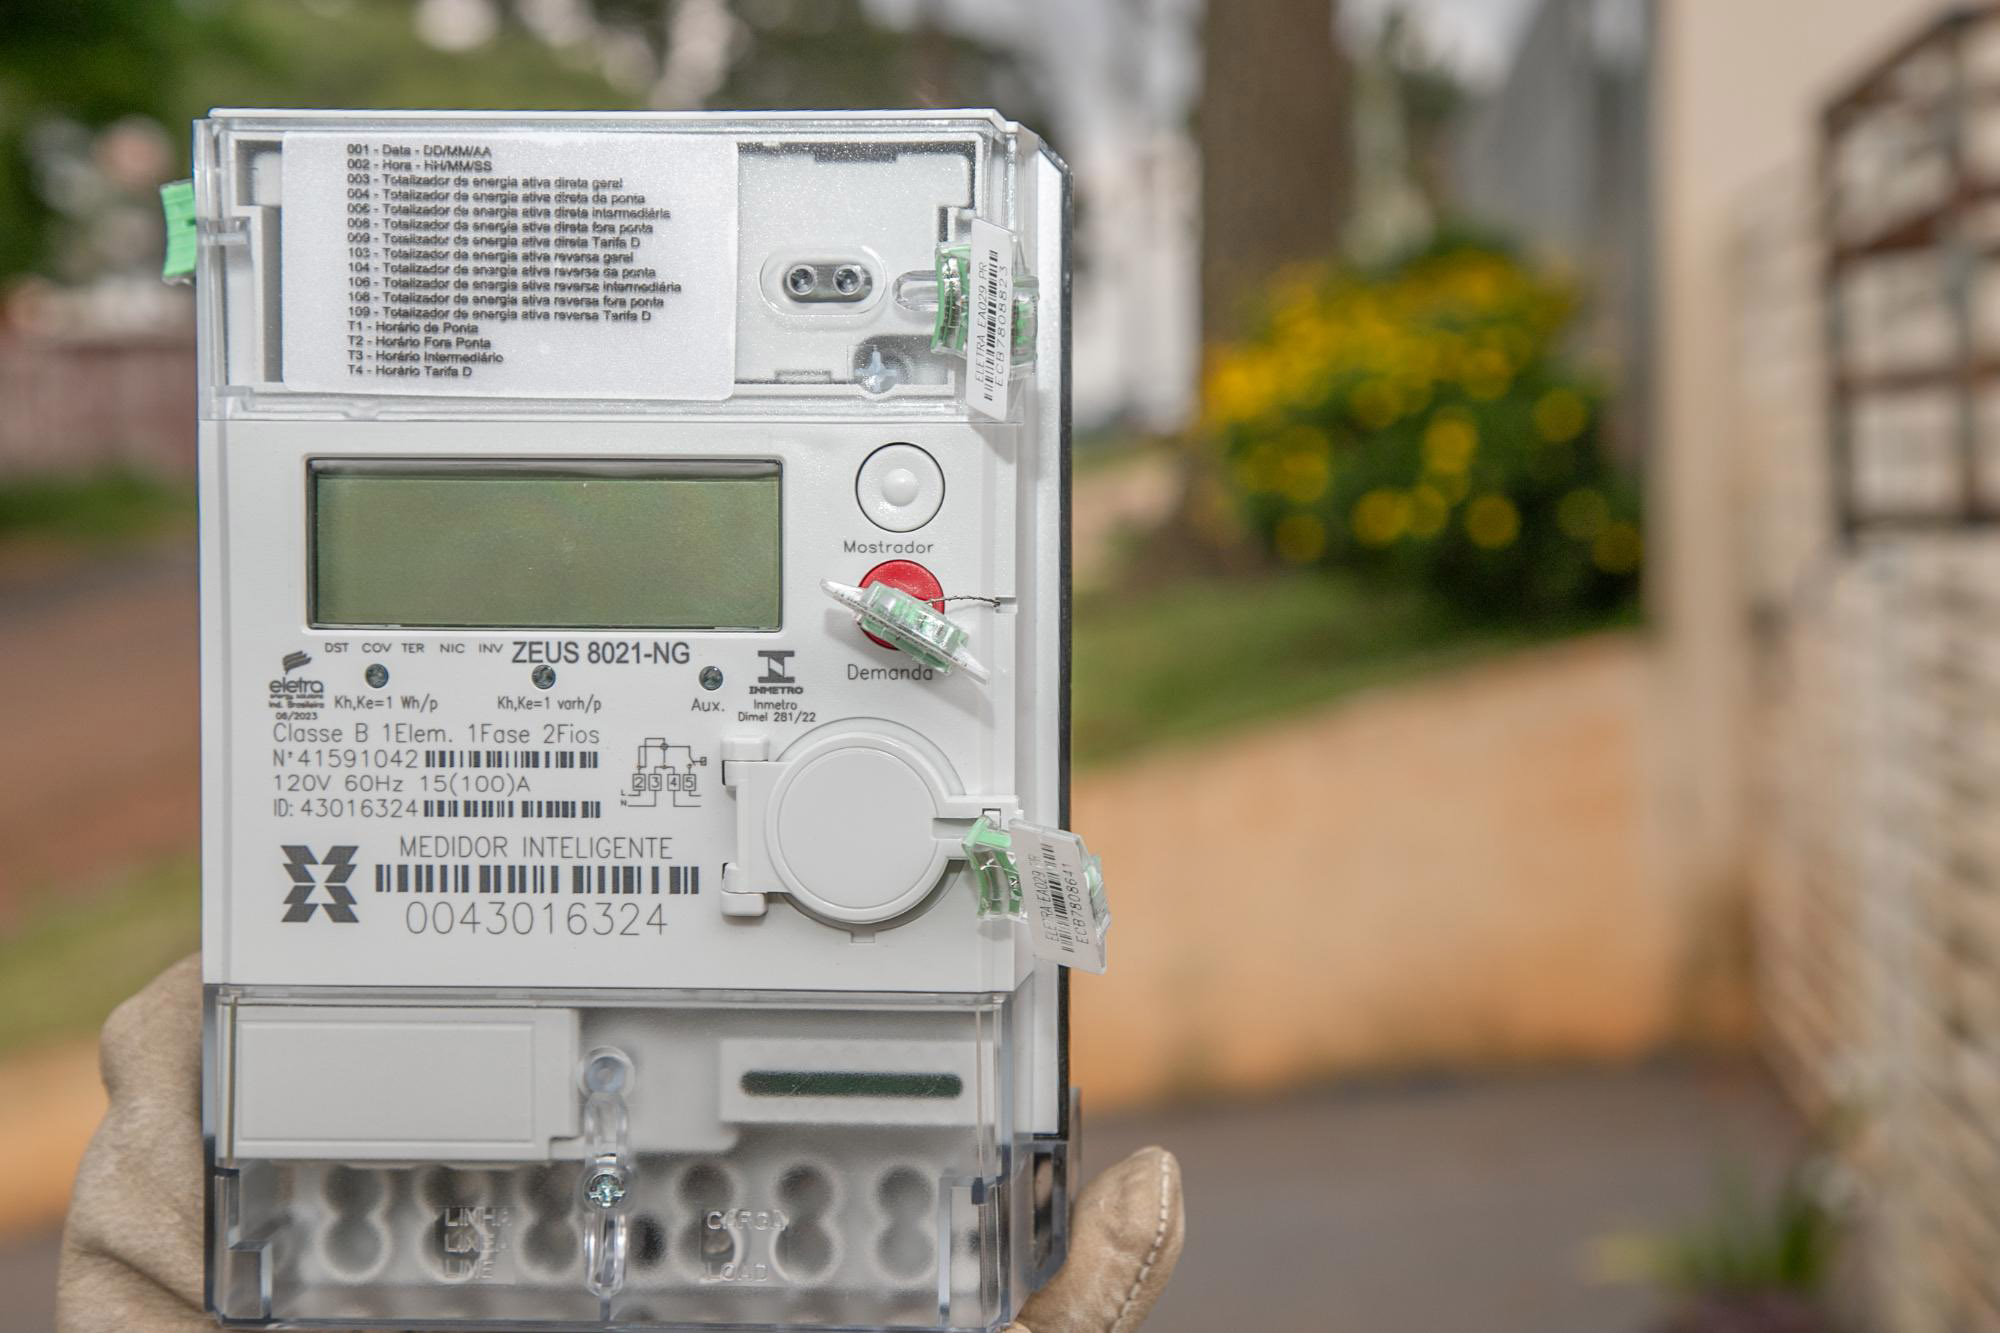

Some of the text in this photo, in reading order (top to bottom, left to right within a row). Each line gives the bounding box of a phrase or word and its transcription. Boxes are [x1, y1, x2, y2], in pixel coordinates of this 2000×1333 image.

[347, 143, 492, 159] 001 Data DD/MM/AA
[347, 159, 369, 174] 002
[383, 159, 411, 175] Hora
[347, 173, 623, 192] 003 Totalizador de energia ativa direta geral
[347, 188, 370, 200] 004
[382, 188, 450, 202] Totalizador
[453, 190, 469, 202] de
[472, 189, 519, 205] energia
[522, 191, 551, 204] ativa
[554, 192, 589, 204] direta
[611, 194, 646, 207] ponta
[382, 204, 450, 218] Totalizador
[453, 205, 469, 217] de
[472, 204, 518, 220] energia
[522, 207, 551, 219] ativa
[554, 206, 589, 220] direta
[347, 217, 653, 237] 008 Totalizador de energia ativa direta fora ponta
[347, 232, 640, 250] 009 Totalizador de energia ativa direta Tarifa D
[382, 247, 450, 261] Totalizador
[453, 249, 470, 261] de
[472, 248, 518, 264] energia
[521, 250, 552, 263] ativa
[554, 253, 601, 264] reversa
[603, 251, 634, 266] geral
[349, 261, 370, 274] 104
[383, 263, 449, 276] Totalizador
[454, 264, 469, 276] de
[473, 263, 517, 279] energia
[522, 265, 550, 277] ativa
[554, 267, 599, 278] reversa
[622, 267, 656, 281] ponta
[382, 277, 450, 291] Totalizador
[453, 278, 469, 290] de
[472, 278, 518, 294] energia
[521, 280, 551, 292] ativa
[554, 282, 600, 293] reversa
[382, 292, 450, 306] Totalizador
[453, 293, 469, 305] de
[472, 293, 518, 309] energia
[521, 294, 550, 307] ativa
[554, 297, 600, 308] reversa
[603, 295, 627, 308] fora
[630, 296, 664, 311] ponta
[348, 306, 651, 323] 109 Totalizador de energia ativa reversa Tarifa D
[976, 262, 987, 383] ELETRA EA029 PR
[347, 321, 479, 335] T1 Horário de Ponta
[995, 265, 1008, 386] ECB7808823
[347, 335, 491, 350] T2 Horário Fora Ponta
[348, 350, 363, 362] T3
[376, 350, 420, 363] Horário
[348, 365, 472, 378] T4 Horário Tarifa D
[843, 541, 934, 553] Mostrador
[324, 643, 504, 653] DST COV TER NIC INV
[511, 641, 690, 666] ZEUS 8021-NG
[847, 662, 934, 681] Demanda
[268, 676, 324, 693] eletra
[748, 686, 804, 694] INMETRO
[334, 694, 438, 712] Kh,Ke=1 Wh/p
[498, 695, 601, 713] Kh,Ke=1 varh/p
[691, 698, 725, 712] Aux.
[753, 699, 800, 710] Inmetro
[738, 711, 816, 724] Dimel 281/22
[273, 723, 599, 744] Classe B 1Elem. 1Fase 2Fios
[274, 772, 530, 797] 120V 60Hz 15(100)A
[635, 776, 694, 788] 2 3 4 5
[274, 798, 417, 817] ID: 43016324
[400, 836, 672, 859] MEDIDOR INTELIGENTE
[406, 901, 668, 935] 0043016324
